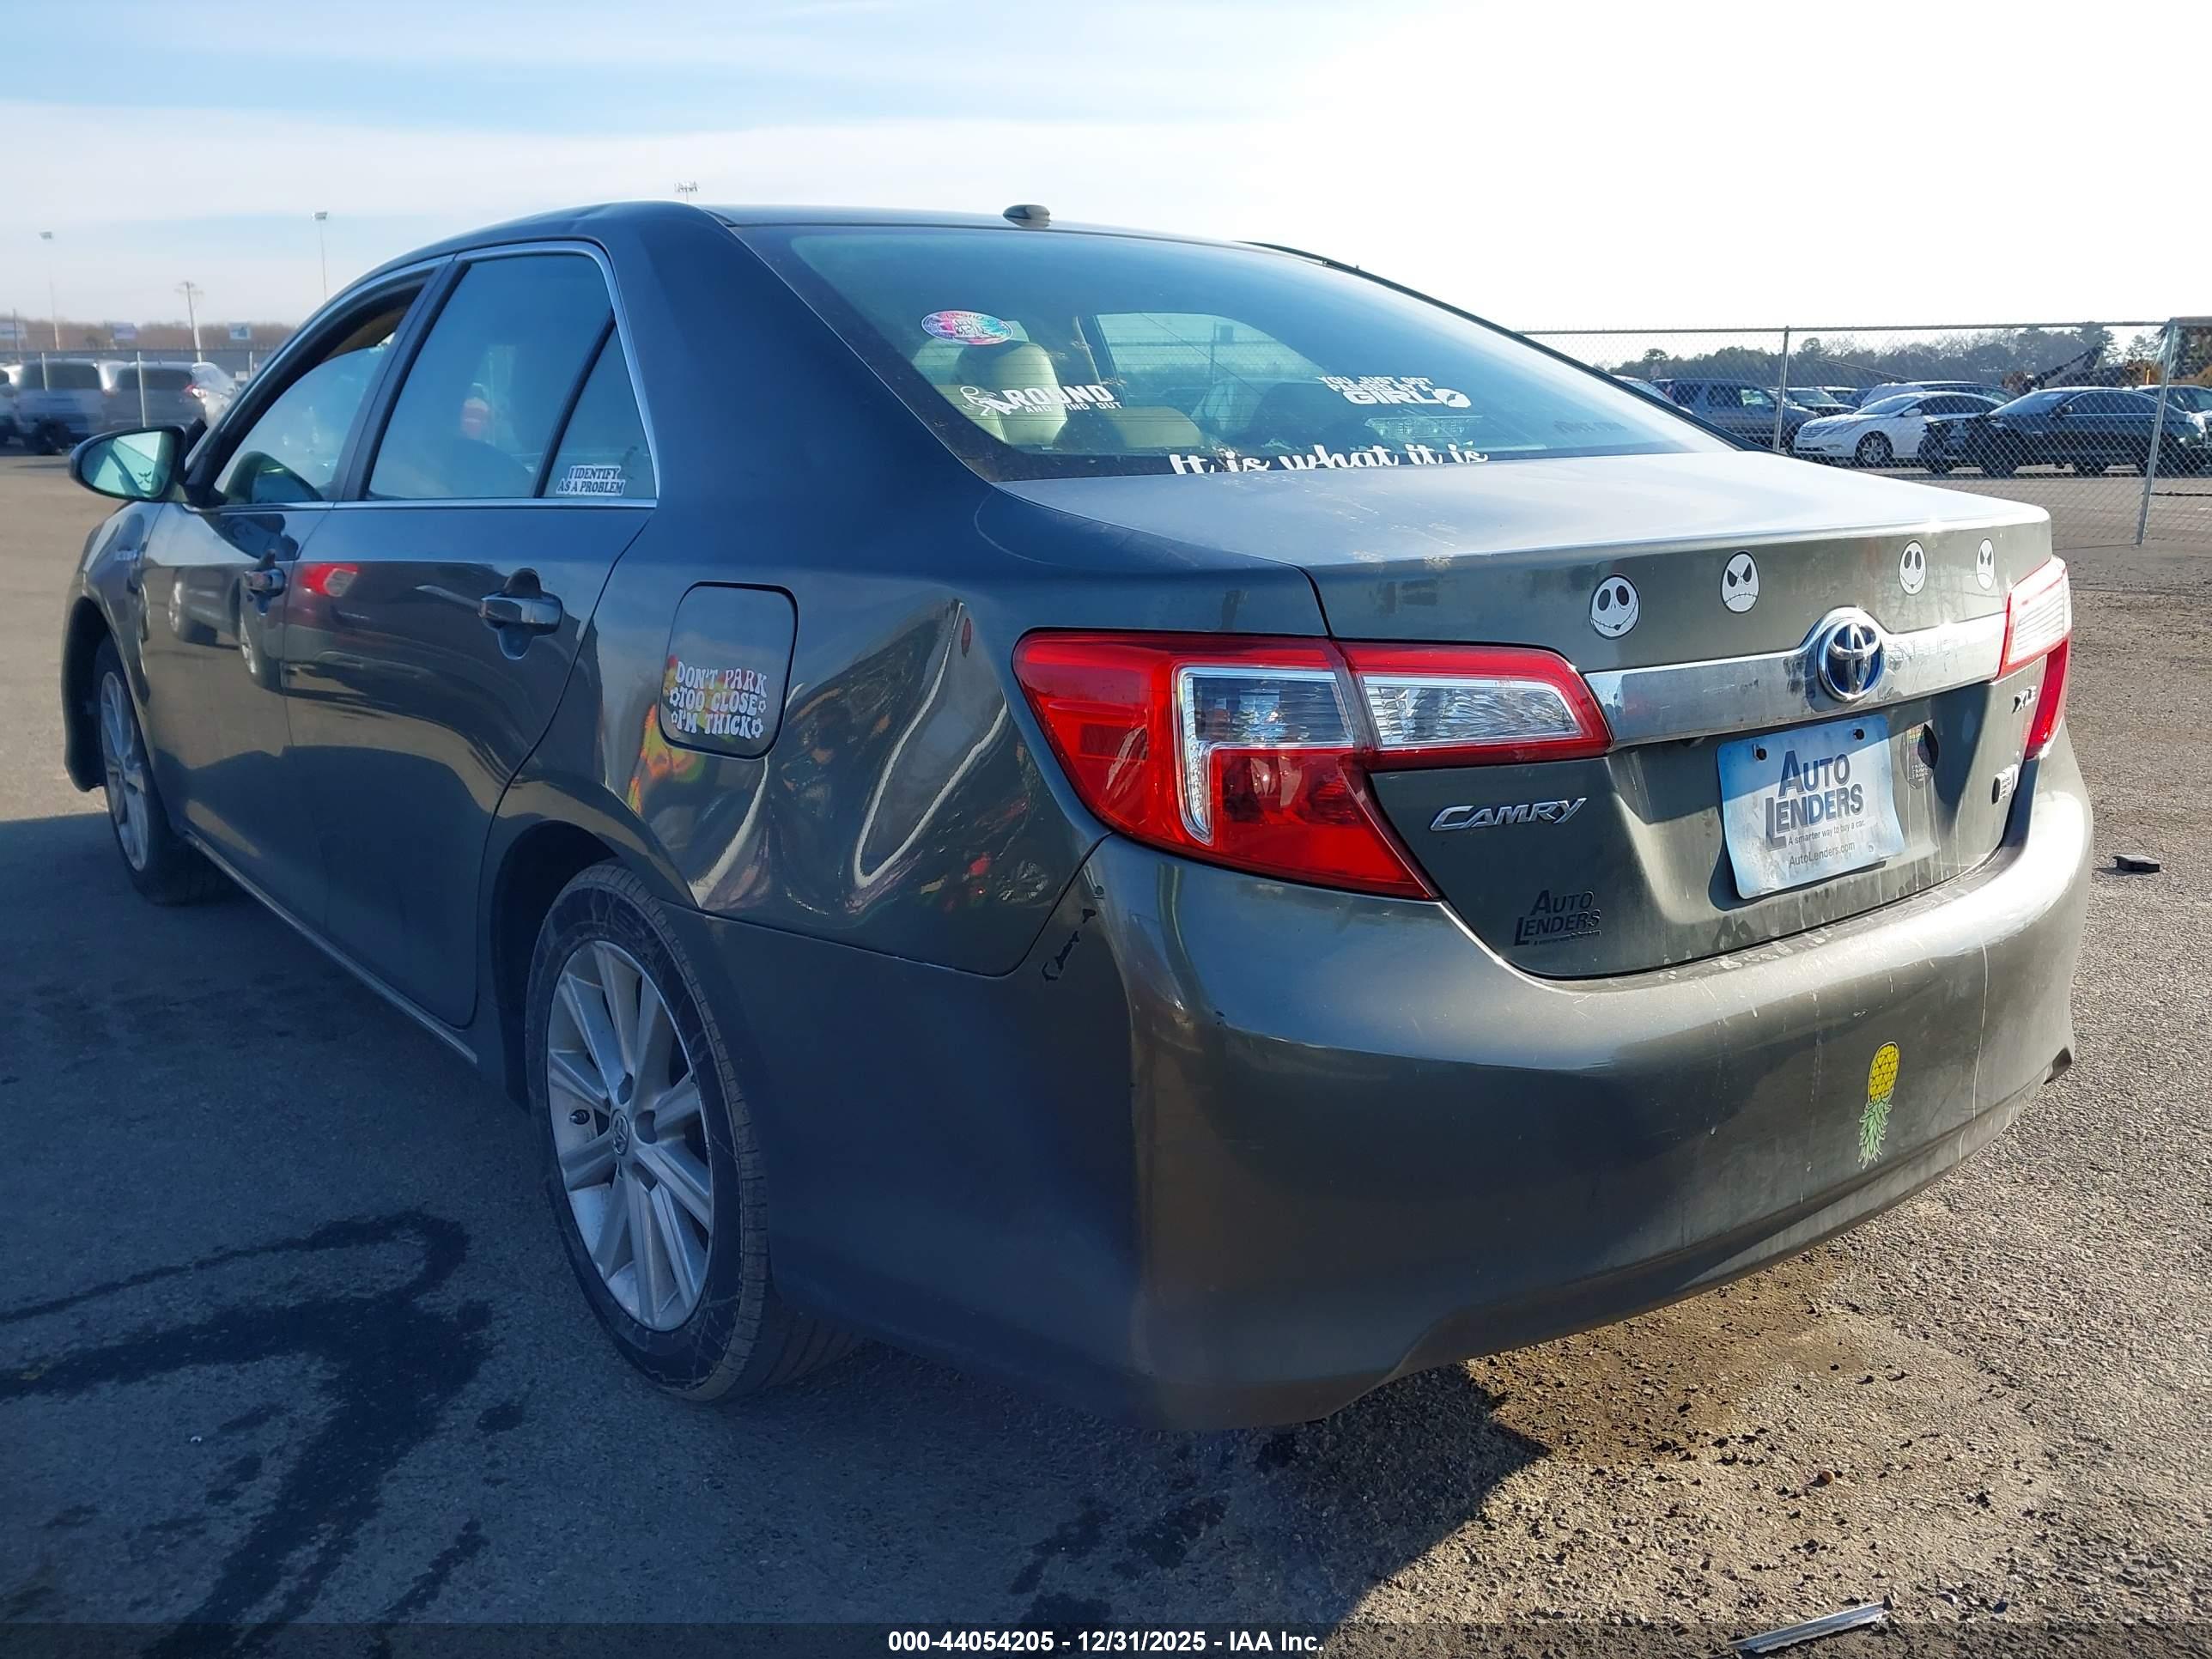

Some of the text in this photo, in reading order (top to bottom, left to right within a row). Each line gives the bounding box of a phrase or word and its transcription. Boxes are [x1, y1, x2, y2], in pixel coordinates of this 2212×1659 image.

[1025, 404, 1052, 413] AND
[1097, 401, 1122, 410] OUT
[1342, 391, 1443, 404] GIRL
[1224, 451, 1271, 472] is
[1278, 444, 1399, 471] what
[1405, 443, 1443, 465] it
[1447, 443, 1489, 464] is
[557, 481, 624, 494] AS A PROBLEM
[675, 660, 767, 698] DON'T PARK
[679, 686, 757, 715] TOO CLOSE
[677, 708, 751, 738] I'M THICK
[1778, 750, 1850, 799] AUTO
[1430, 797, 1588, 831] CAMRY
[1765, 783, 1864, 852] LENDERS
[1788, 836, 1794, 846] A
[1794, 830, 1820, 844] smarter
[1821, 828, 1832, 838] way
[1833, 825, 1839, 834] to
[1840, 822, 1850, 832] buy
[1789, 842, 1855, 868] AutoLenders.com
[1529, 890, 1595, 916] AUTO
[1513, 908, 1601, 947] LENDERS
